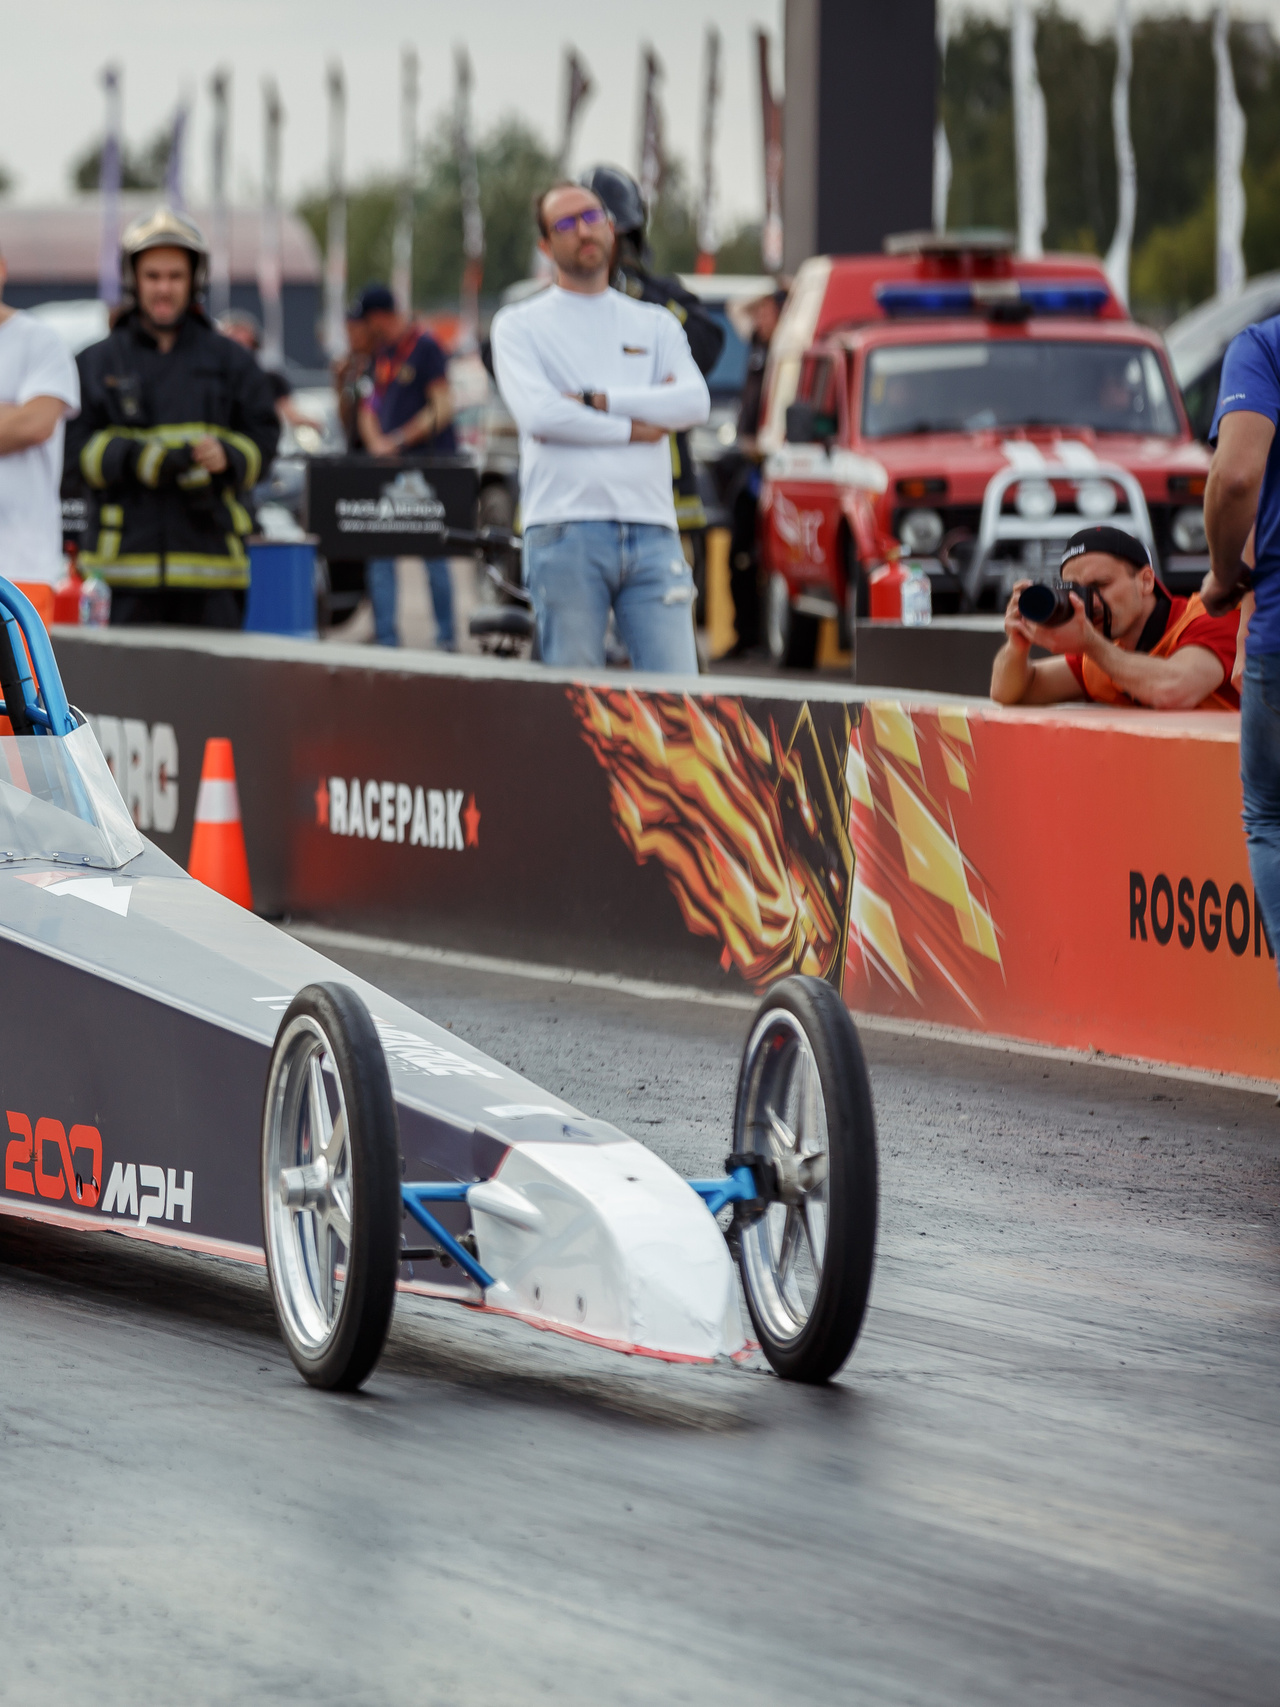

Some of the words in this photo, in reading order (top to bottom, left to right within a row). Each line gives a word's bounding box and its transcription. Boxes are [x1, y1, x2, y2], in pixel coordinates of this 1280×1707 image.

[328, 776, 465, 851] RACEPARK
[5, 1110, 103, 1208] 200
[101, 1161, 194, 1227] MPH
